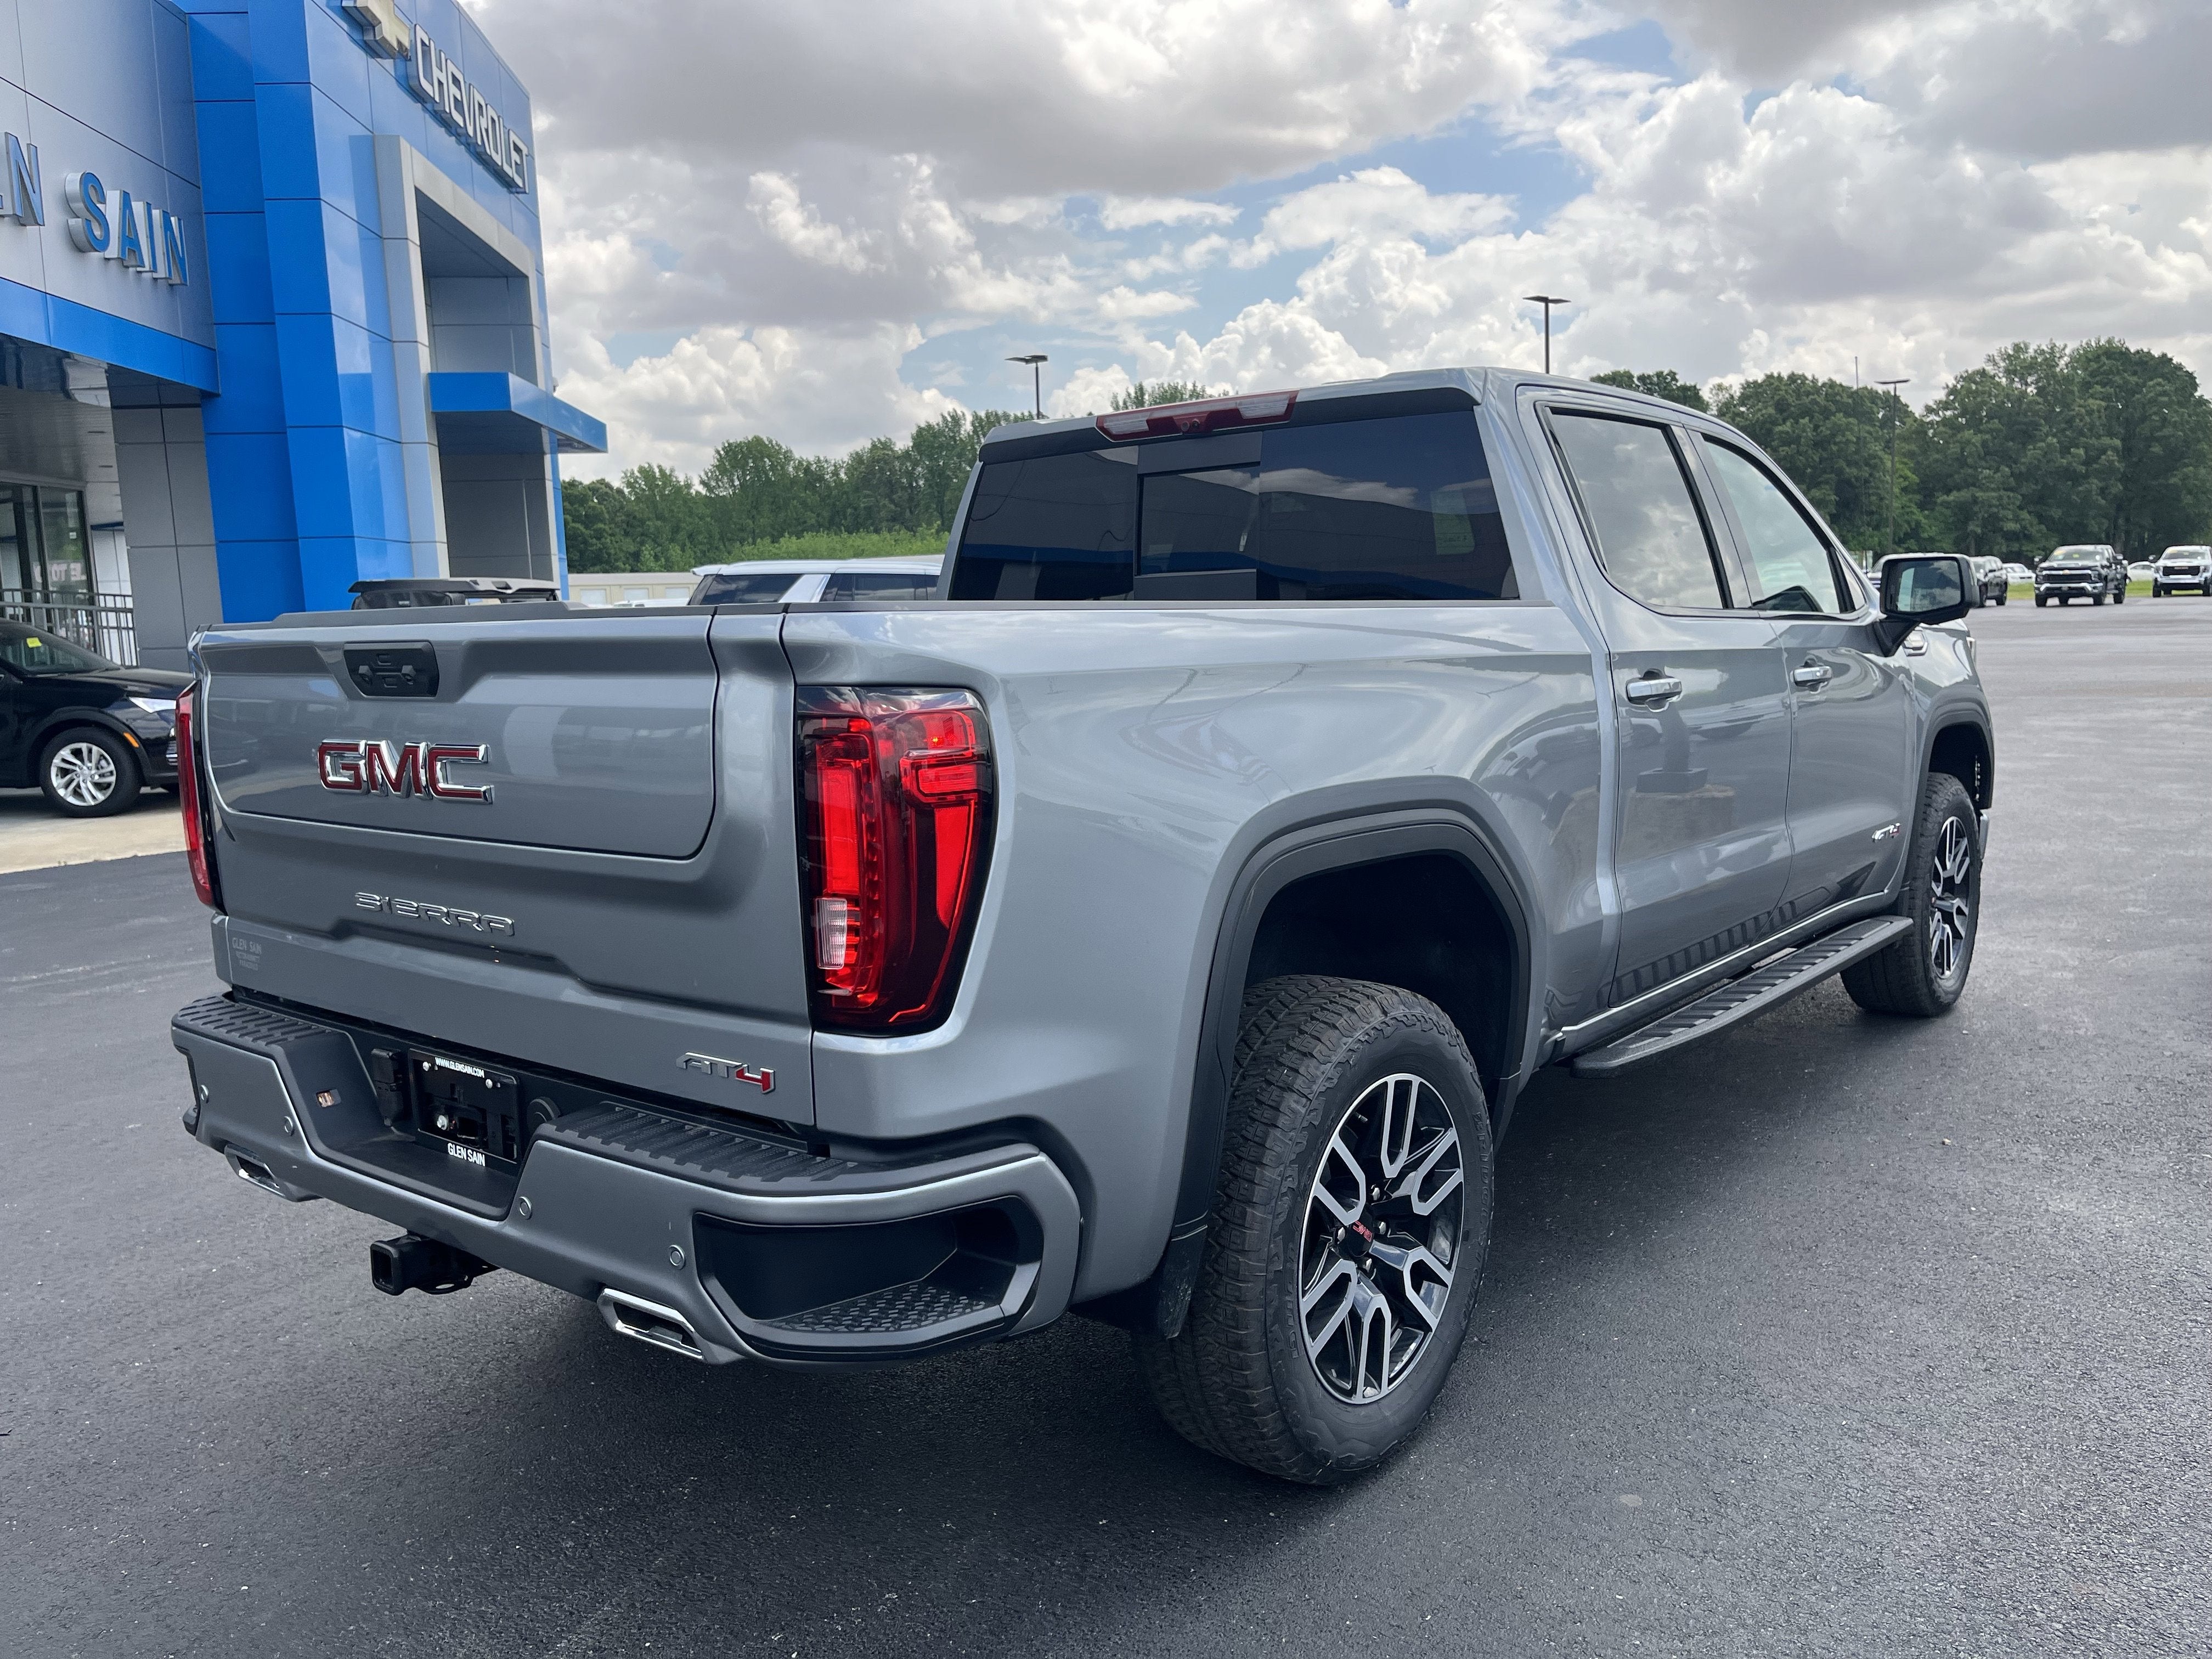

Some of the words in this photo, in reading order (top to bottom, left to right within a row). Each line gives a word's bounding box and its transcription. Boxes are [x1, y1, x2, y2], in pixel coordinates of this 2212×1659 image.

[413, 23, 529, 195] CHEVROLET
[0, 131, 45, 227] N
[65, 171, 189, 286] SAIN
[317, 739, 495, 804] GMC
[355, 891, 515, 936] SIERRA
[435, 1057, 485, 1078] WWW.GLENSAIN.COM
[676, 1052, 775, 1094] AT4
[447, 1142, 467, 1160] GLEN
[467, 1149, 486, 1167] SAIN
